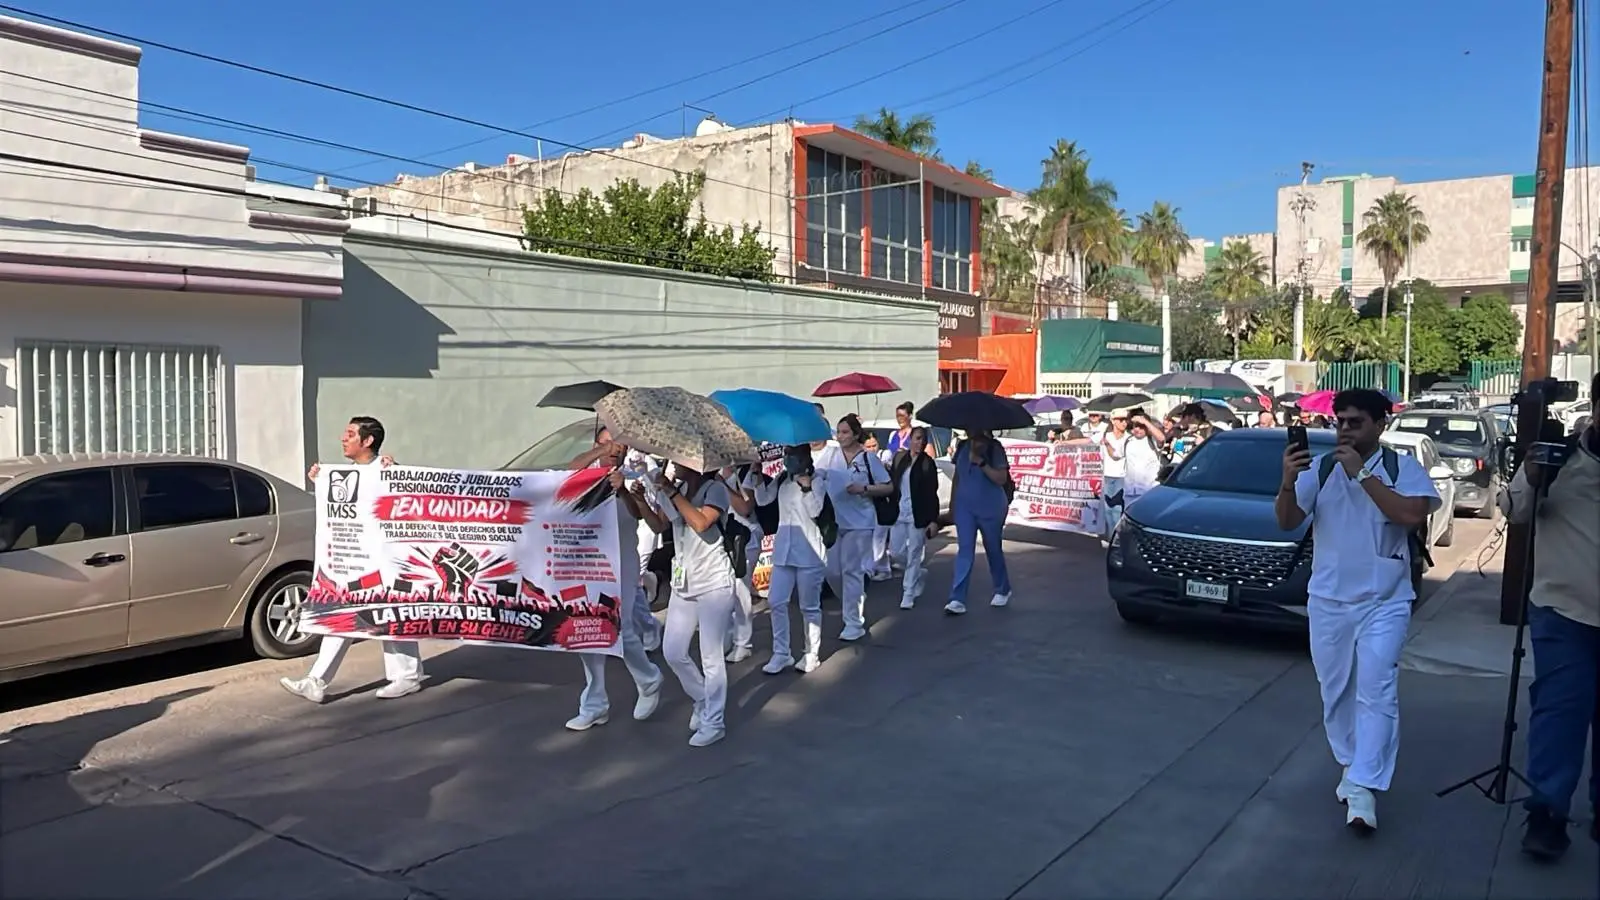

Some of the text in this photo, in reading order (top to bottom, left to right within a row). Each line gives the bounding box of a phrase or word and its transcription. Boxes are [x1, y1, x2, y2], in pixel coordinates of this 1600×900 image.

[389, 482, 510, 498] PENSIONADOS Y ACTIVOS
[327, 503, 357, 519] IMSS
[390, 496, 511, 521] ¡EN UNIDAD!
[1029, 503, 1043, 514] SE
[380, 522, 393, 530] POR
[405, 523, 437, 531] DEFENSA
[447, 525, 459, 533] LOS
[460, 525, 496, 534] DERECHOS
[497, 526, 507, 534] DE
[508, 527, 523, 535] LOS
[384, 531, 443, 539] TRABAJADORES
[458, 533, 487, 542] SEGURO
[488, 534, 517, 542] SOCIAL
[372, 605, 543, 630] LA FUERZA DEL IMSS
[573, 618, 602, 627] UNIDOS
[437, 621, 456, 633] EN
[459, 621, 479, 634] SU
[480, 622, 525, 640] GENTE
